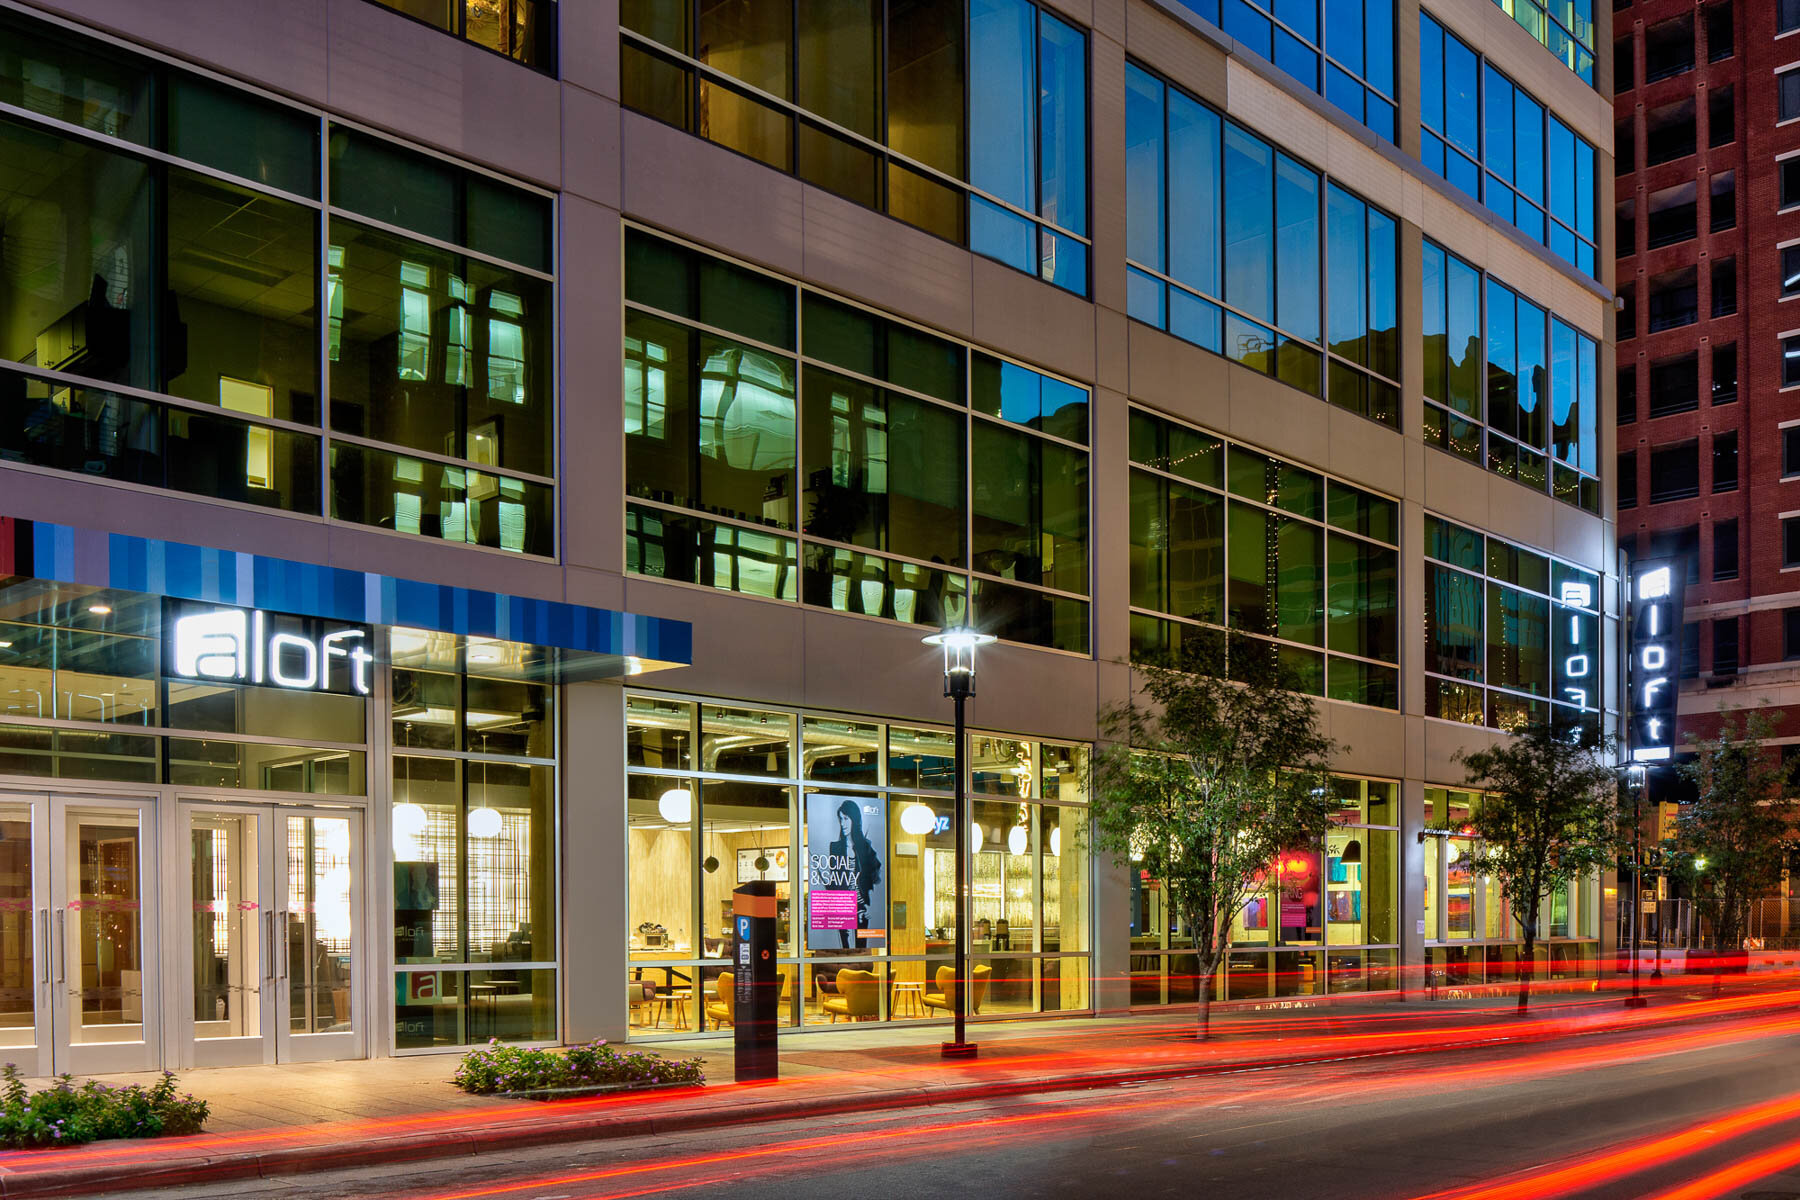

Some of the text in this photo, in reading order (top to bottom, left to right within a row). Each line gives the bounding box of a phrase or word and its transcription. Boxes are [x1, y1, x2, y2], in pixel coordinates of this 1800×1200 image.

[174, 609, 373, 695] aloft
[1639, 566, 1671, 741] aloft
[933, 815, 950, 835] yz
[811, 854, 855, 870] SOCIAL
[810, 870, 860, 887] & SAVVY
[740, 918, 749, 936] P
